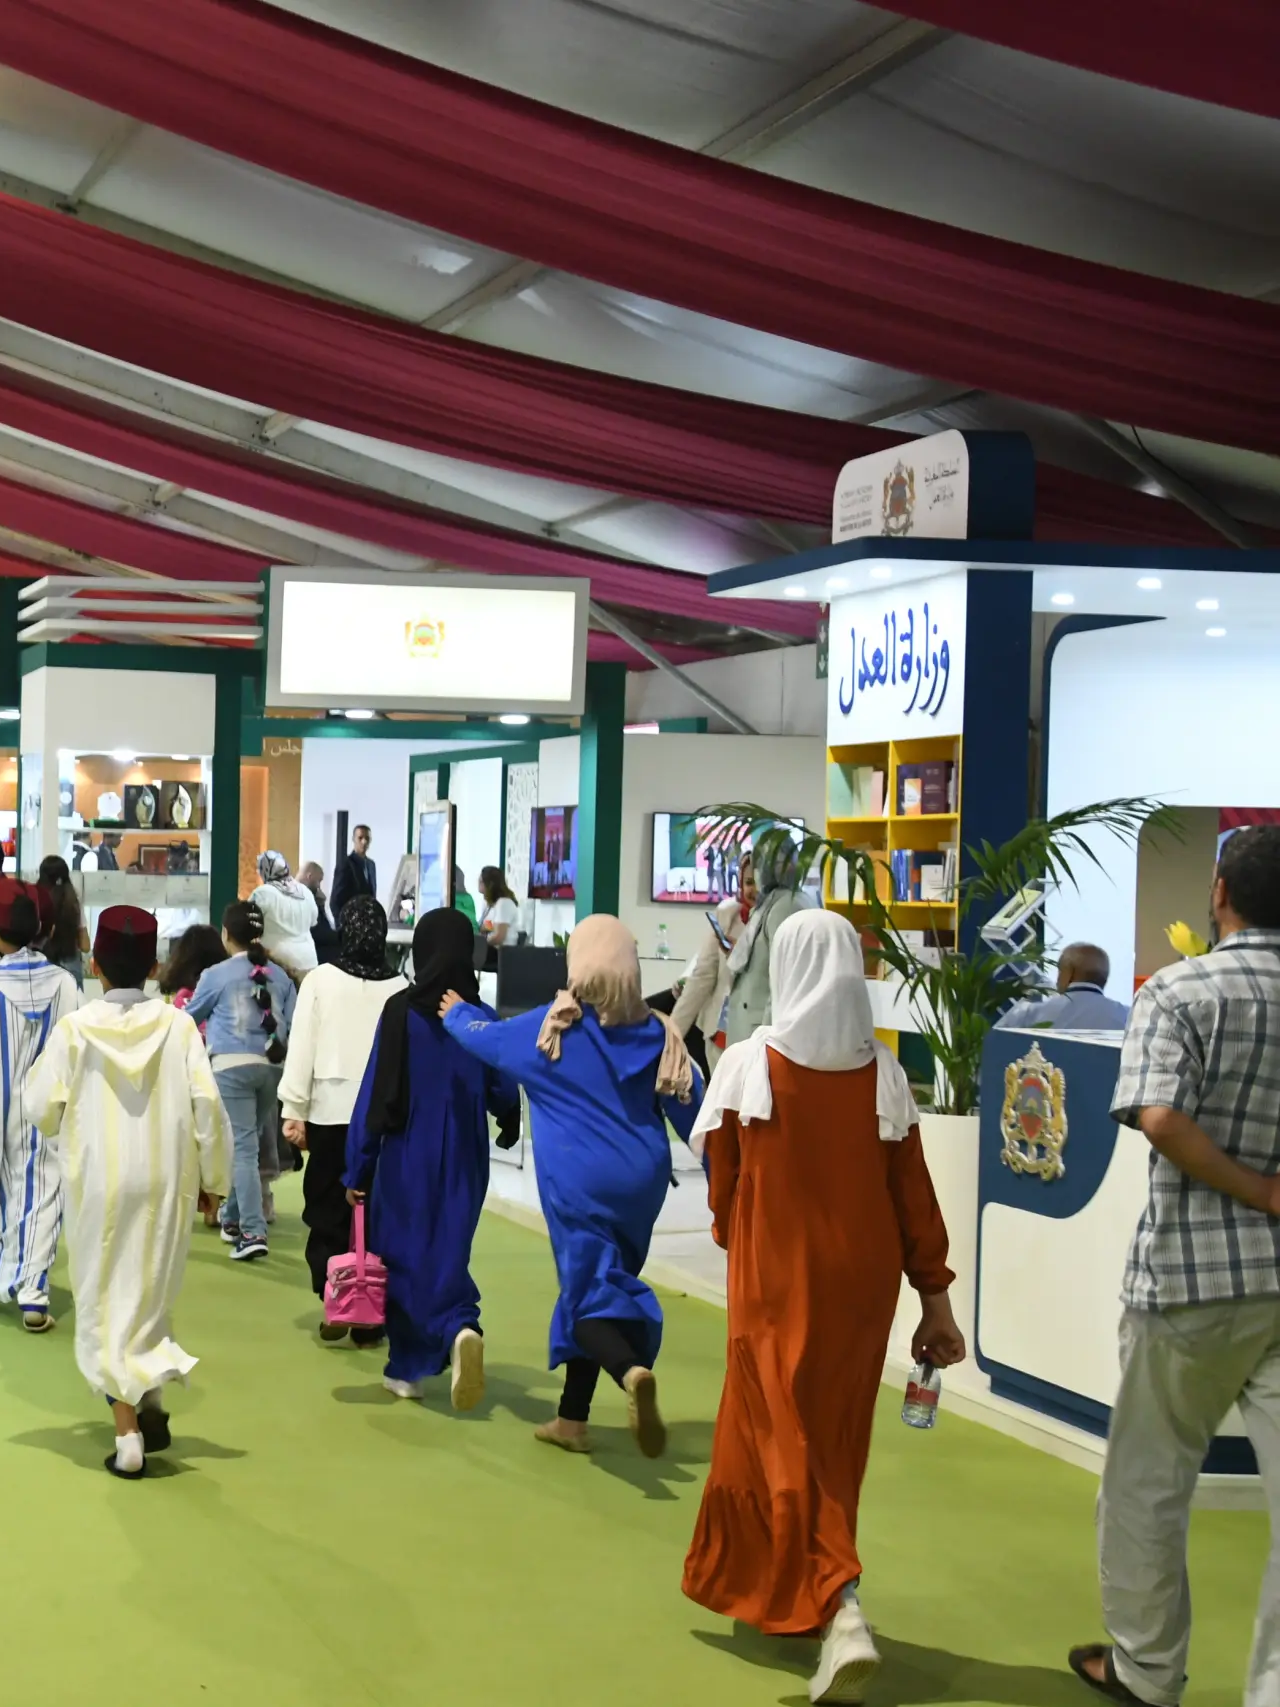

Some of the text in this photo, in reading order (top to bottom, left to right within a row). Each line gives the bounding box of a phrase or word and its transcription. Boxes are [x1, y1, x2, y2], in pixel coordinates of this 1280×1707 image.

[839, 602, 950, 717] وزارة العدل
[271, 739, 303, 758] جلس
